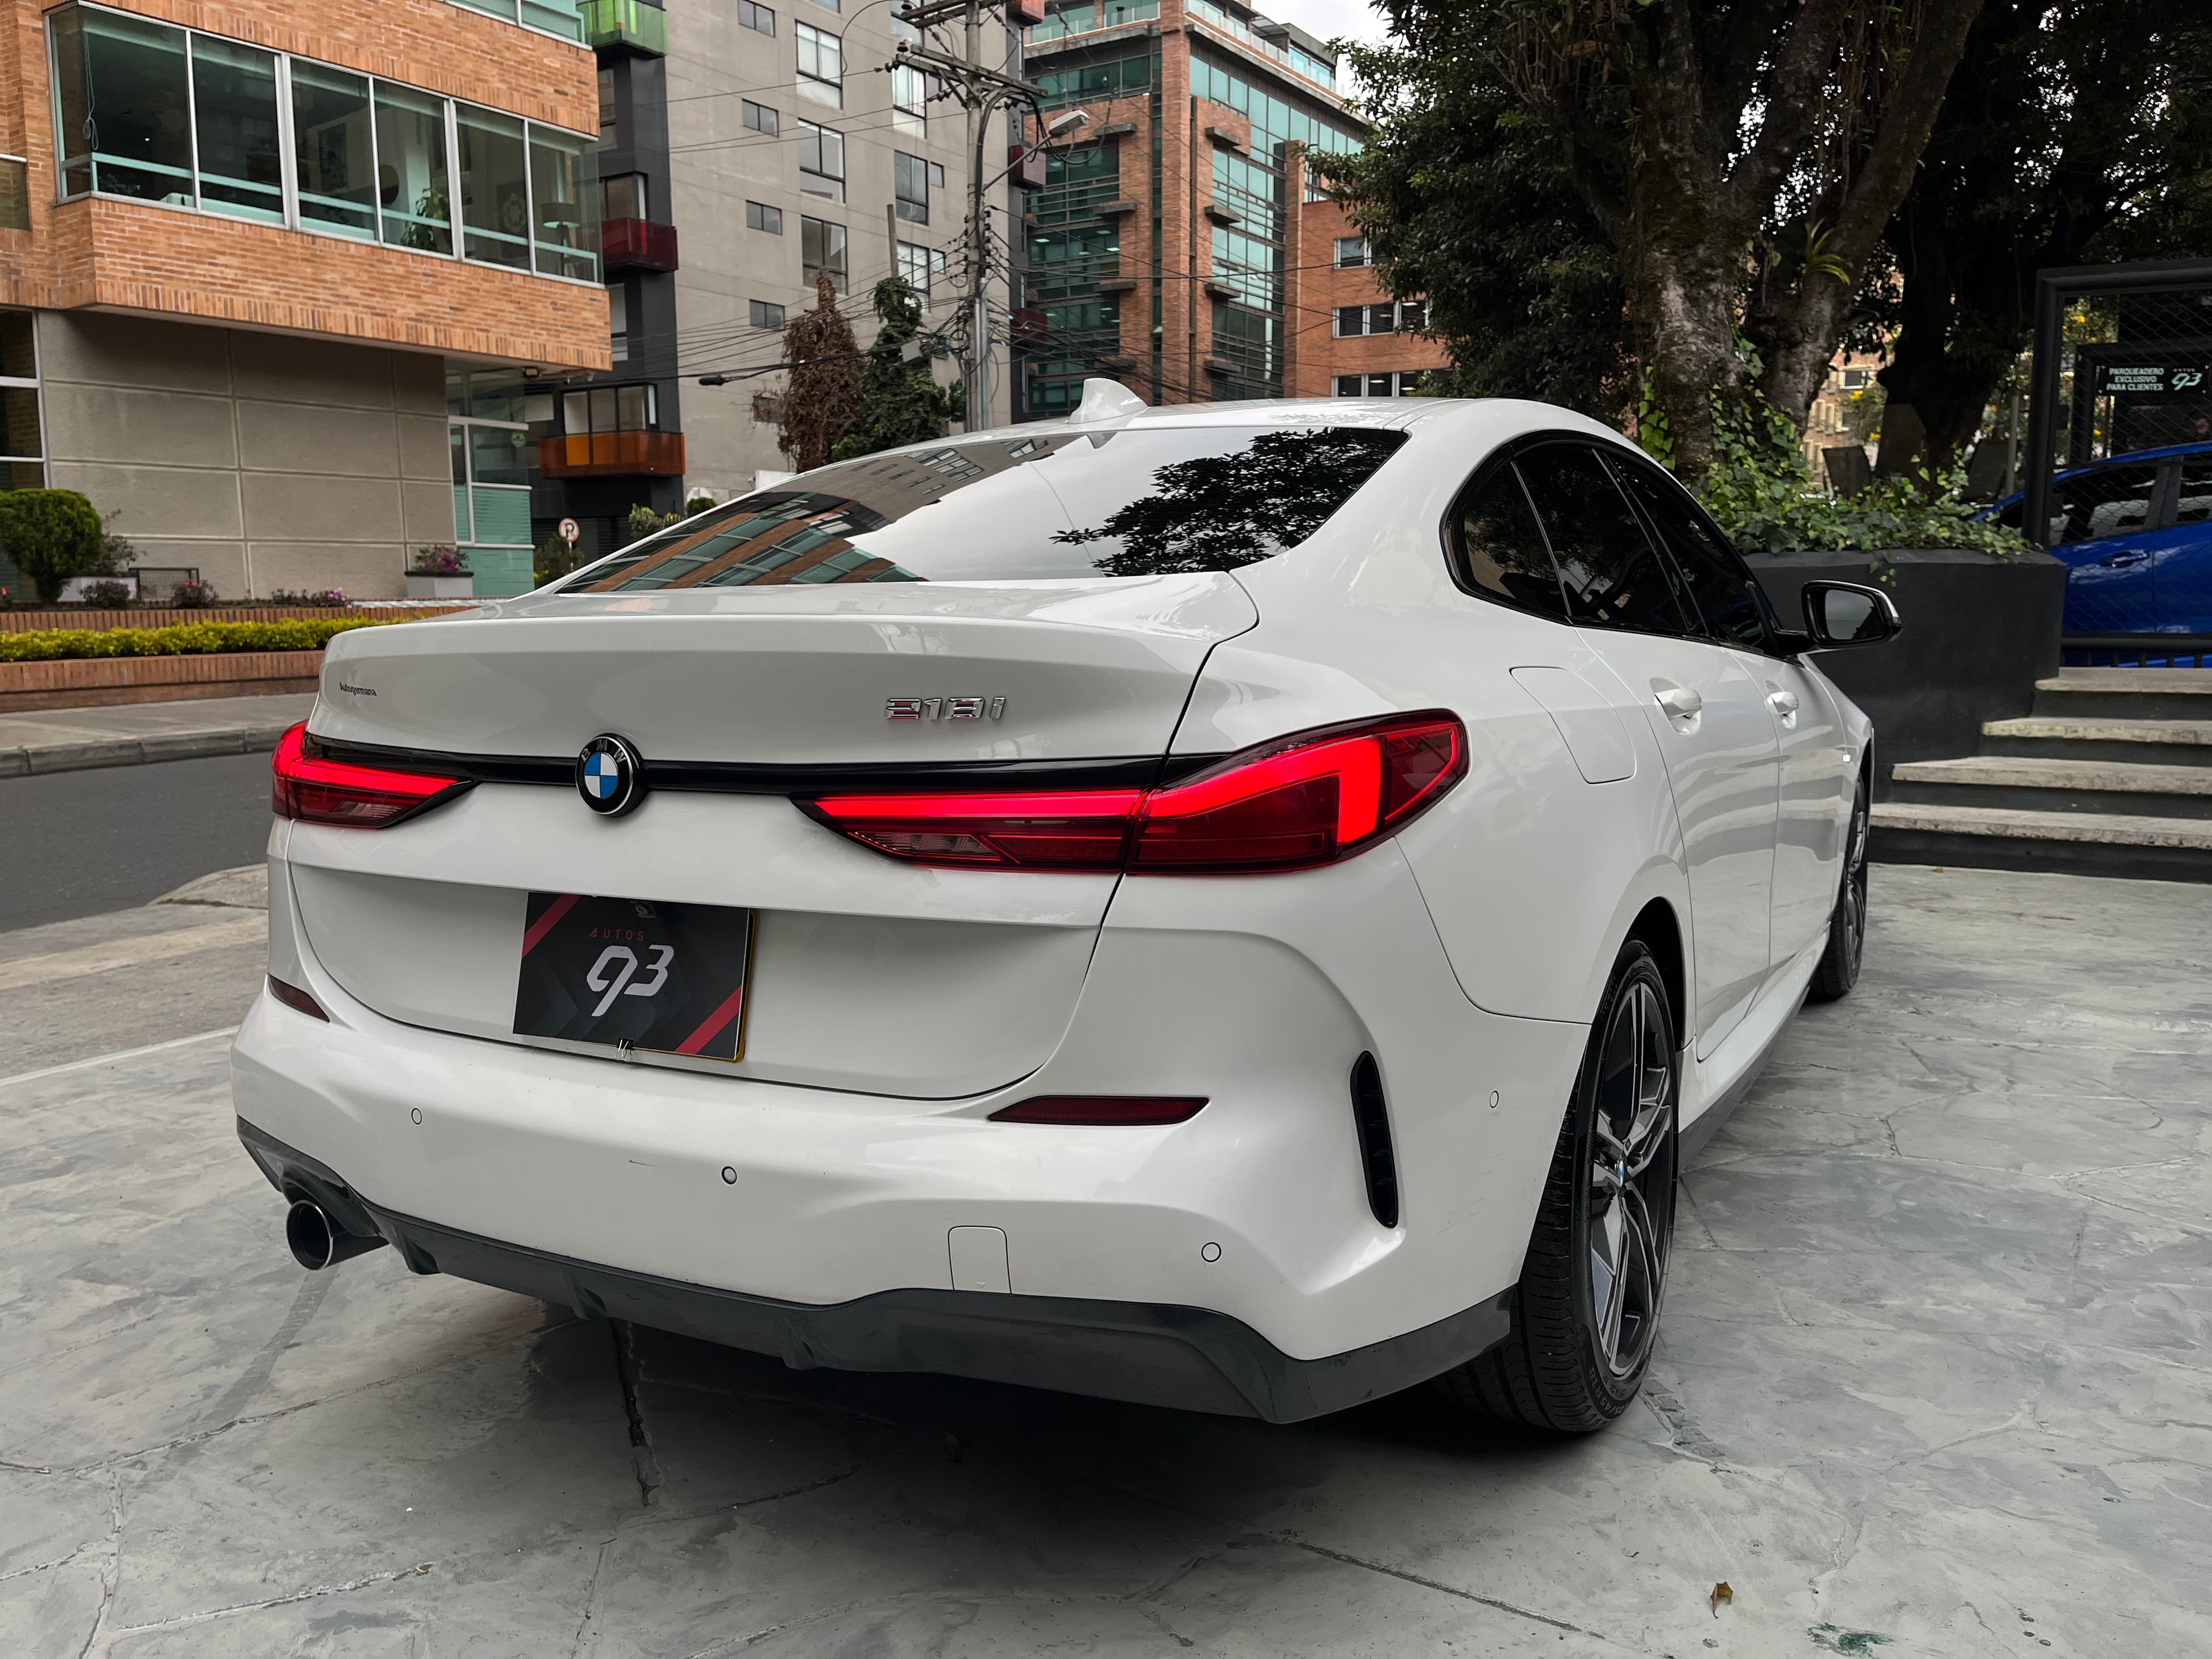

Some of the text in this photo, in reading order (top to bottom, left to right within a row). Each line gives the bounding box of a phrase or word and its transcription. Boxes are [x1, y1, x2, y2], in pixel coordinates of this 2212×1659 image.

[2171, 373, 2202, 391] 93
[566, 522, 575, 538] P
[884, 696, 1006, 720] 218i
[581, 739, 627, 763] BMW
[589, 927, 645, 941] AUTOS
[586, 944, 675, 1017] 93
